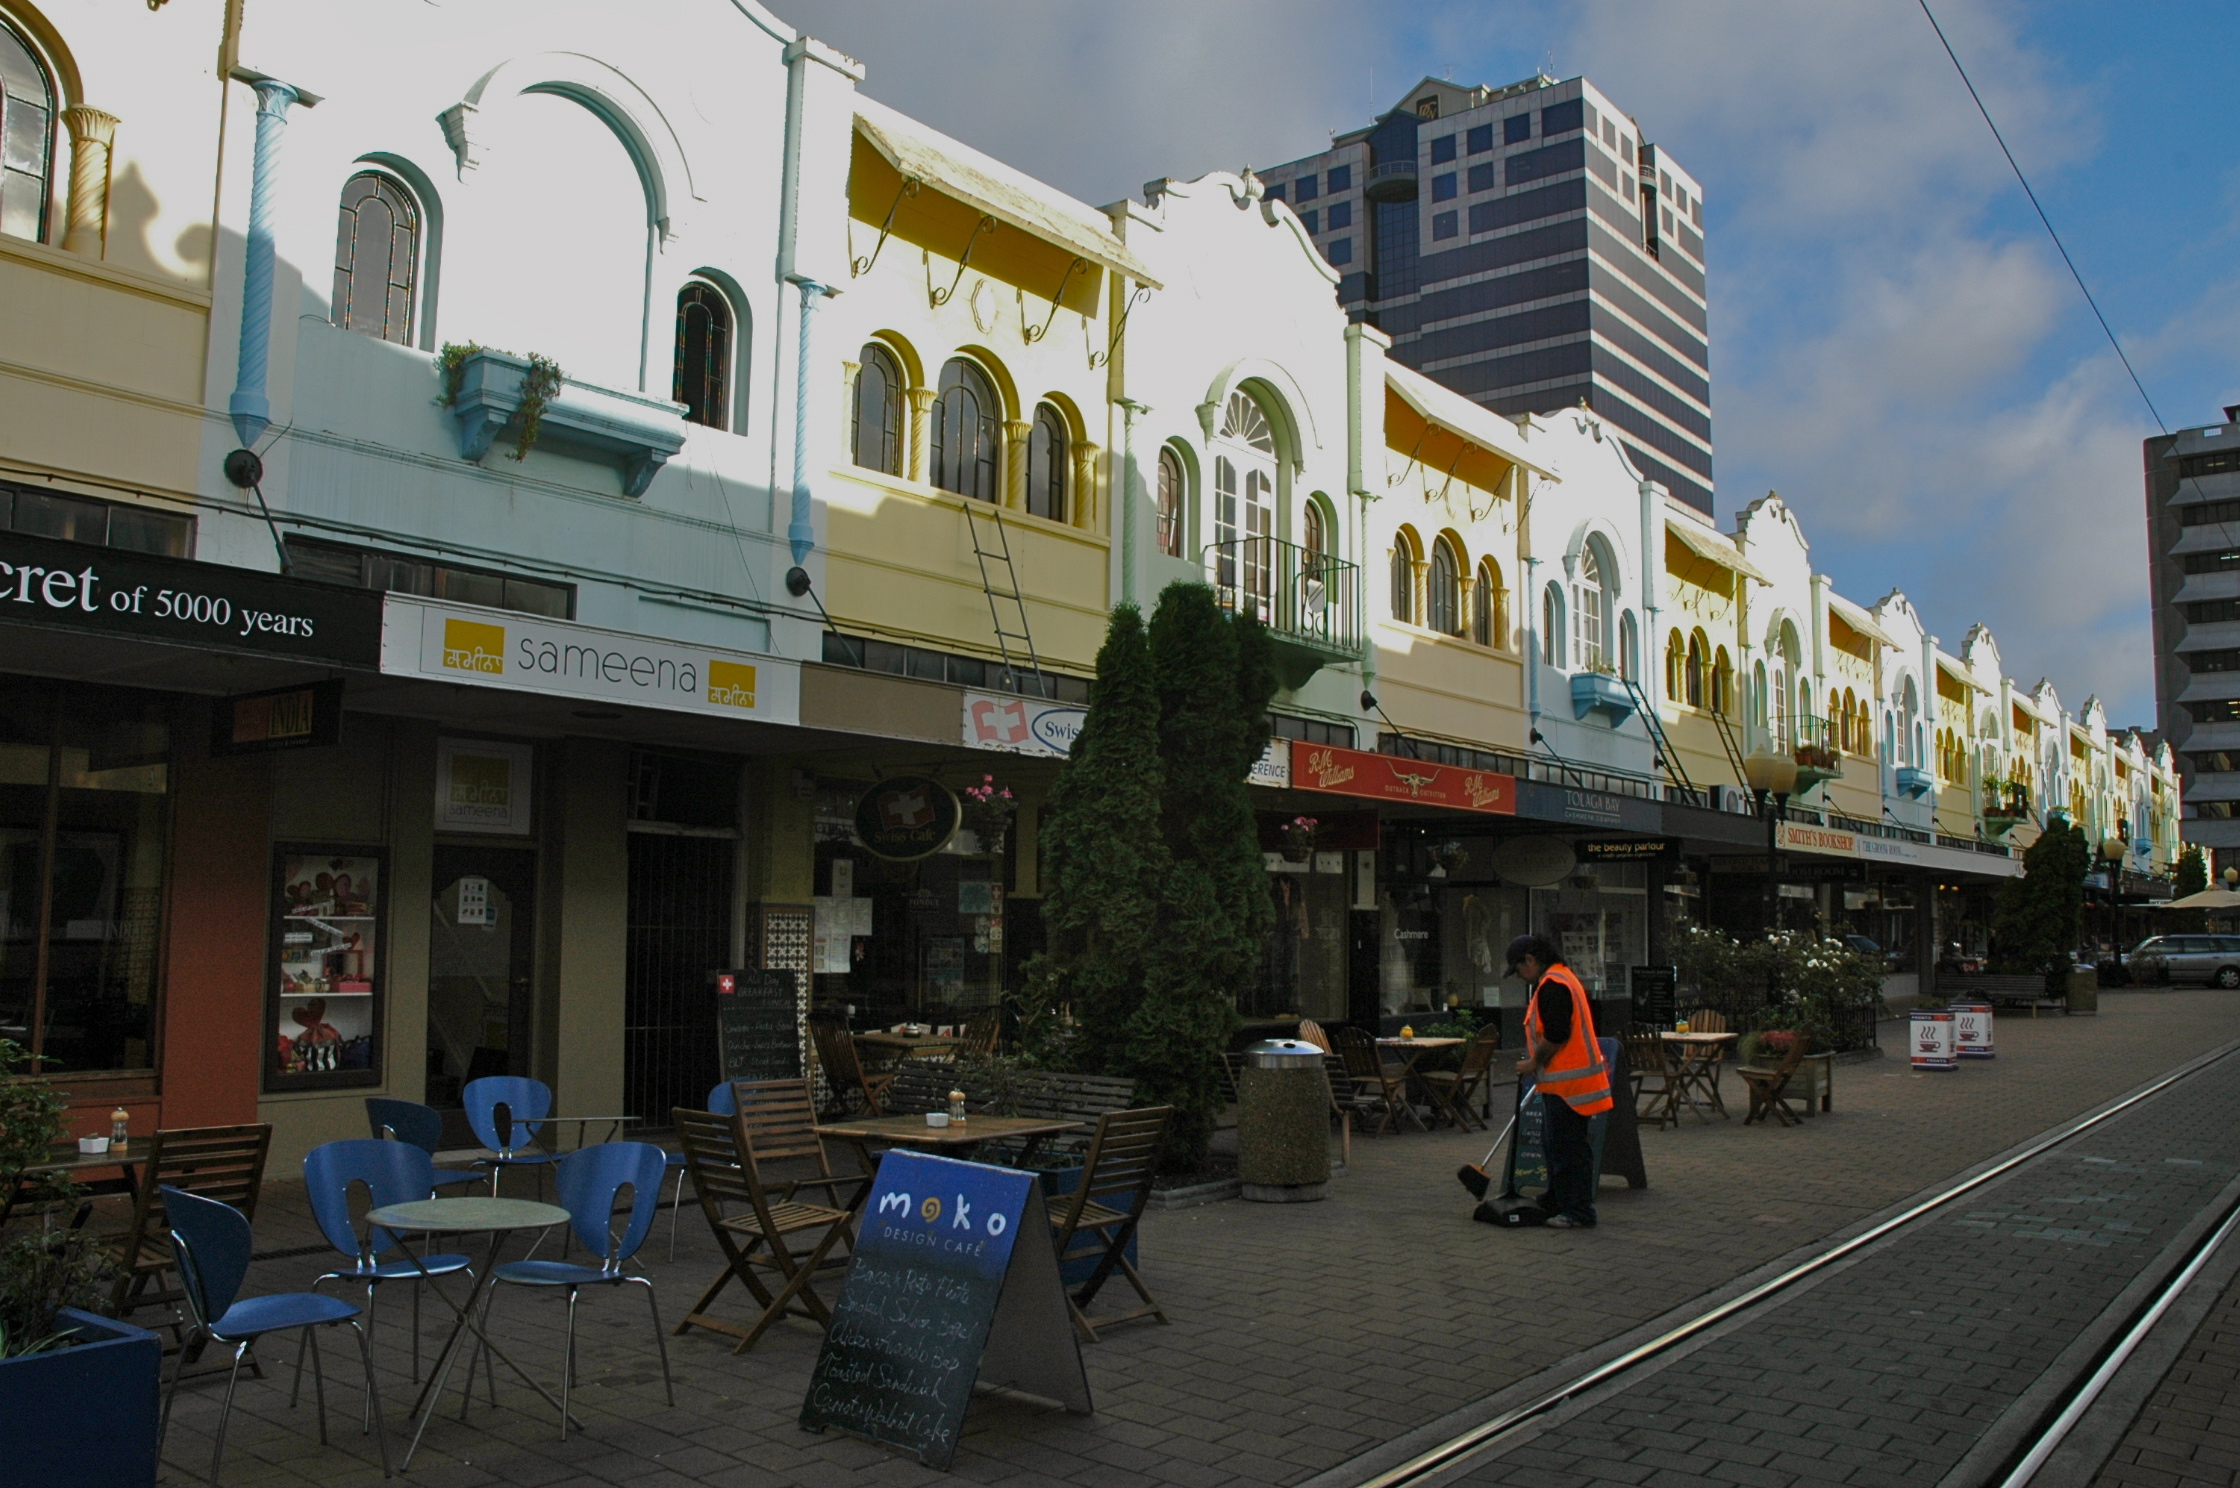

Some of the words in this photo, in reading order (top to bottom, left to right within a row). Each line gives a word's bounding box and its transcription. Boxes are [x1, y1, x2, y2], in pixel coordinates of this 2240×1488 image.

[111, 586, 148, 614] of
[155, 590, 231, 626] 5000
[240, 609, 314, 637] years
[518, 638, 697, 694] sameena
[271, 694, 310, 735] INDIA
[1251, 763, 1286, 778] ERENCE
[1319, 764, 1355, 788] Williams
[1384, 785, 1409, 794] OUTBACK
[450, 804, 508, 819] sameena
[1565, 790, 1603, 809] TOLAGA
[1605, 797, 1621, 812] BAY
[875, 831, 907, 843] Swiss
[1587, 843, 1602, 852] the
[1604, 843, 1633, 853] beauty
[1634, 842, 1666, 852] parlour
[1788, 827, 1818, 847] SMITH'S
[1819, 832, 1854, 851] BOOKSHOP
[1394, 928, 1430, 940] Cashmere
[738, 987, 784, 998] BREAKFAST
[884, 1226, 937, 1247] DESIGN
[818, 1352, 875, 1387] Toasted
[874, 1363, 948, 1409] Sandwich
[813, 1382, 860, 1417] Carrot
[864, 1398, 916, 1436] Walnut
[916, 1412, 951, 1452] Cake
